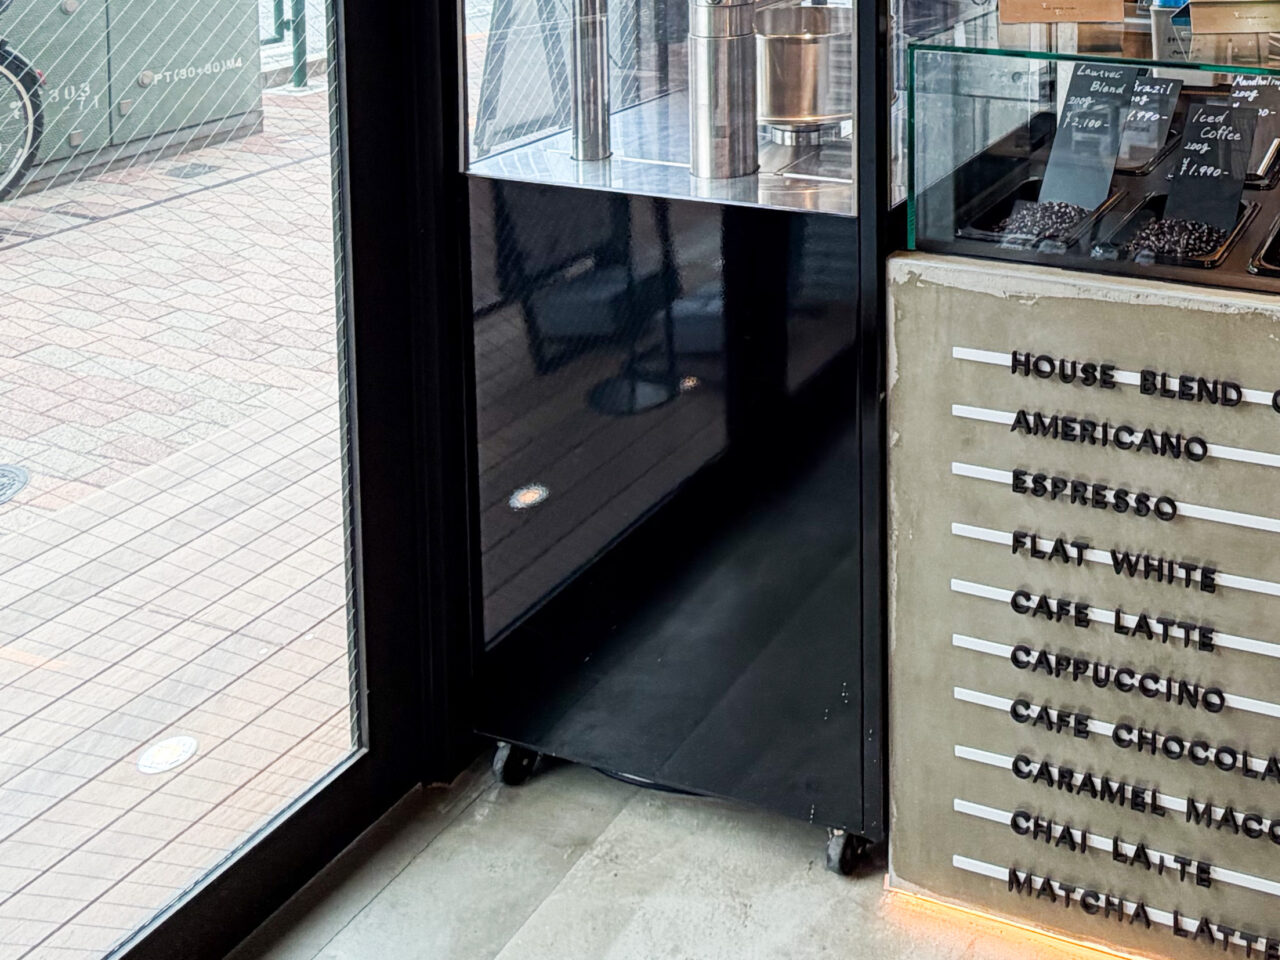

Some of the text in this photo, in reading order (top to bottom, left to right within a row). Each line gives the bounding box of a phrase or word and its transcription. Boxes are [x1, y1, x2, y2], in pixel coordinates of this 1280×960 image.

[1192, 108, 1230, 124] Iced
[1200, 125, 1242, 141] Coffee
[1011, 350, 1116, 390] HOUSE
[1139, 369, 1242, 407] BLEND
[1010, 409, 1208, 462] AMERICANO
[1011, 468, 1178, 522] ESPRESSO
[1011, 530, 1217, 593] FLAT WHITE
[1010, 590, 1215, 652] CAFE LATTE
[1010, 645, 1226, 713] CAPPUCCINO
[1010, 699, 1090, 739] CAFE
[1012, 754, 1166, 817] CARAMEL
[1010, 810, 1088, 854] CHAI
[1008, 868, 1280, 960] MATCHA LATTE
